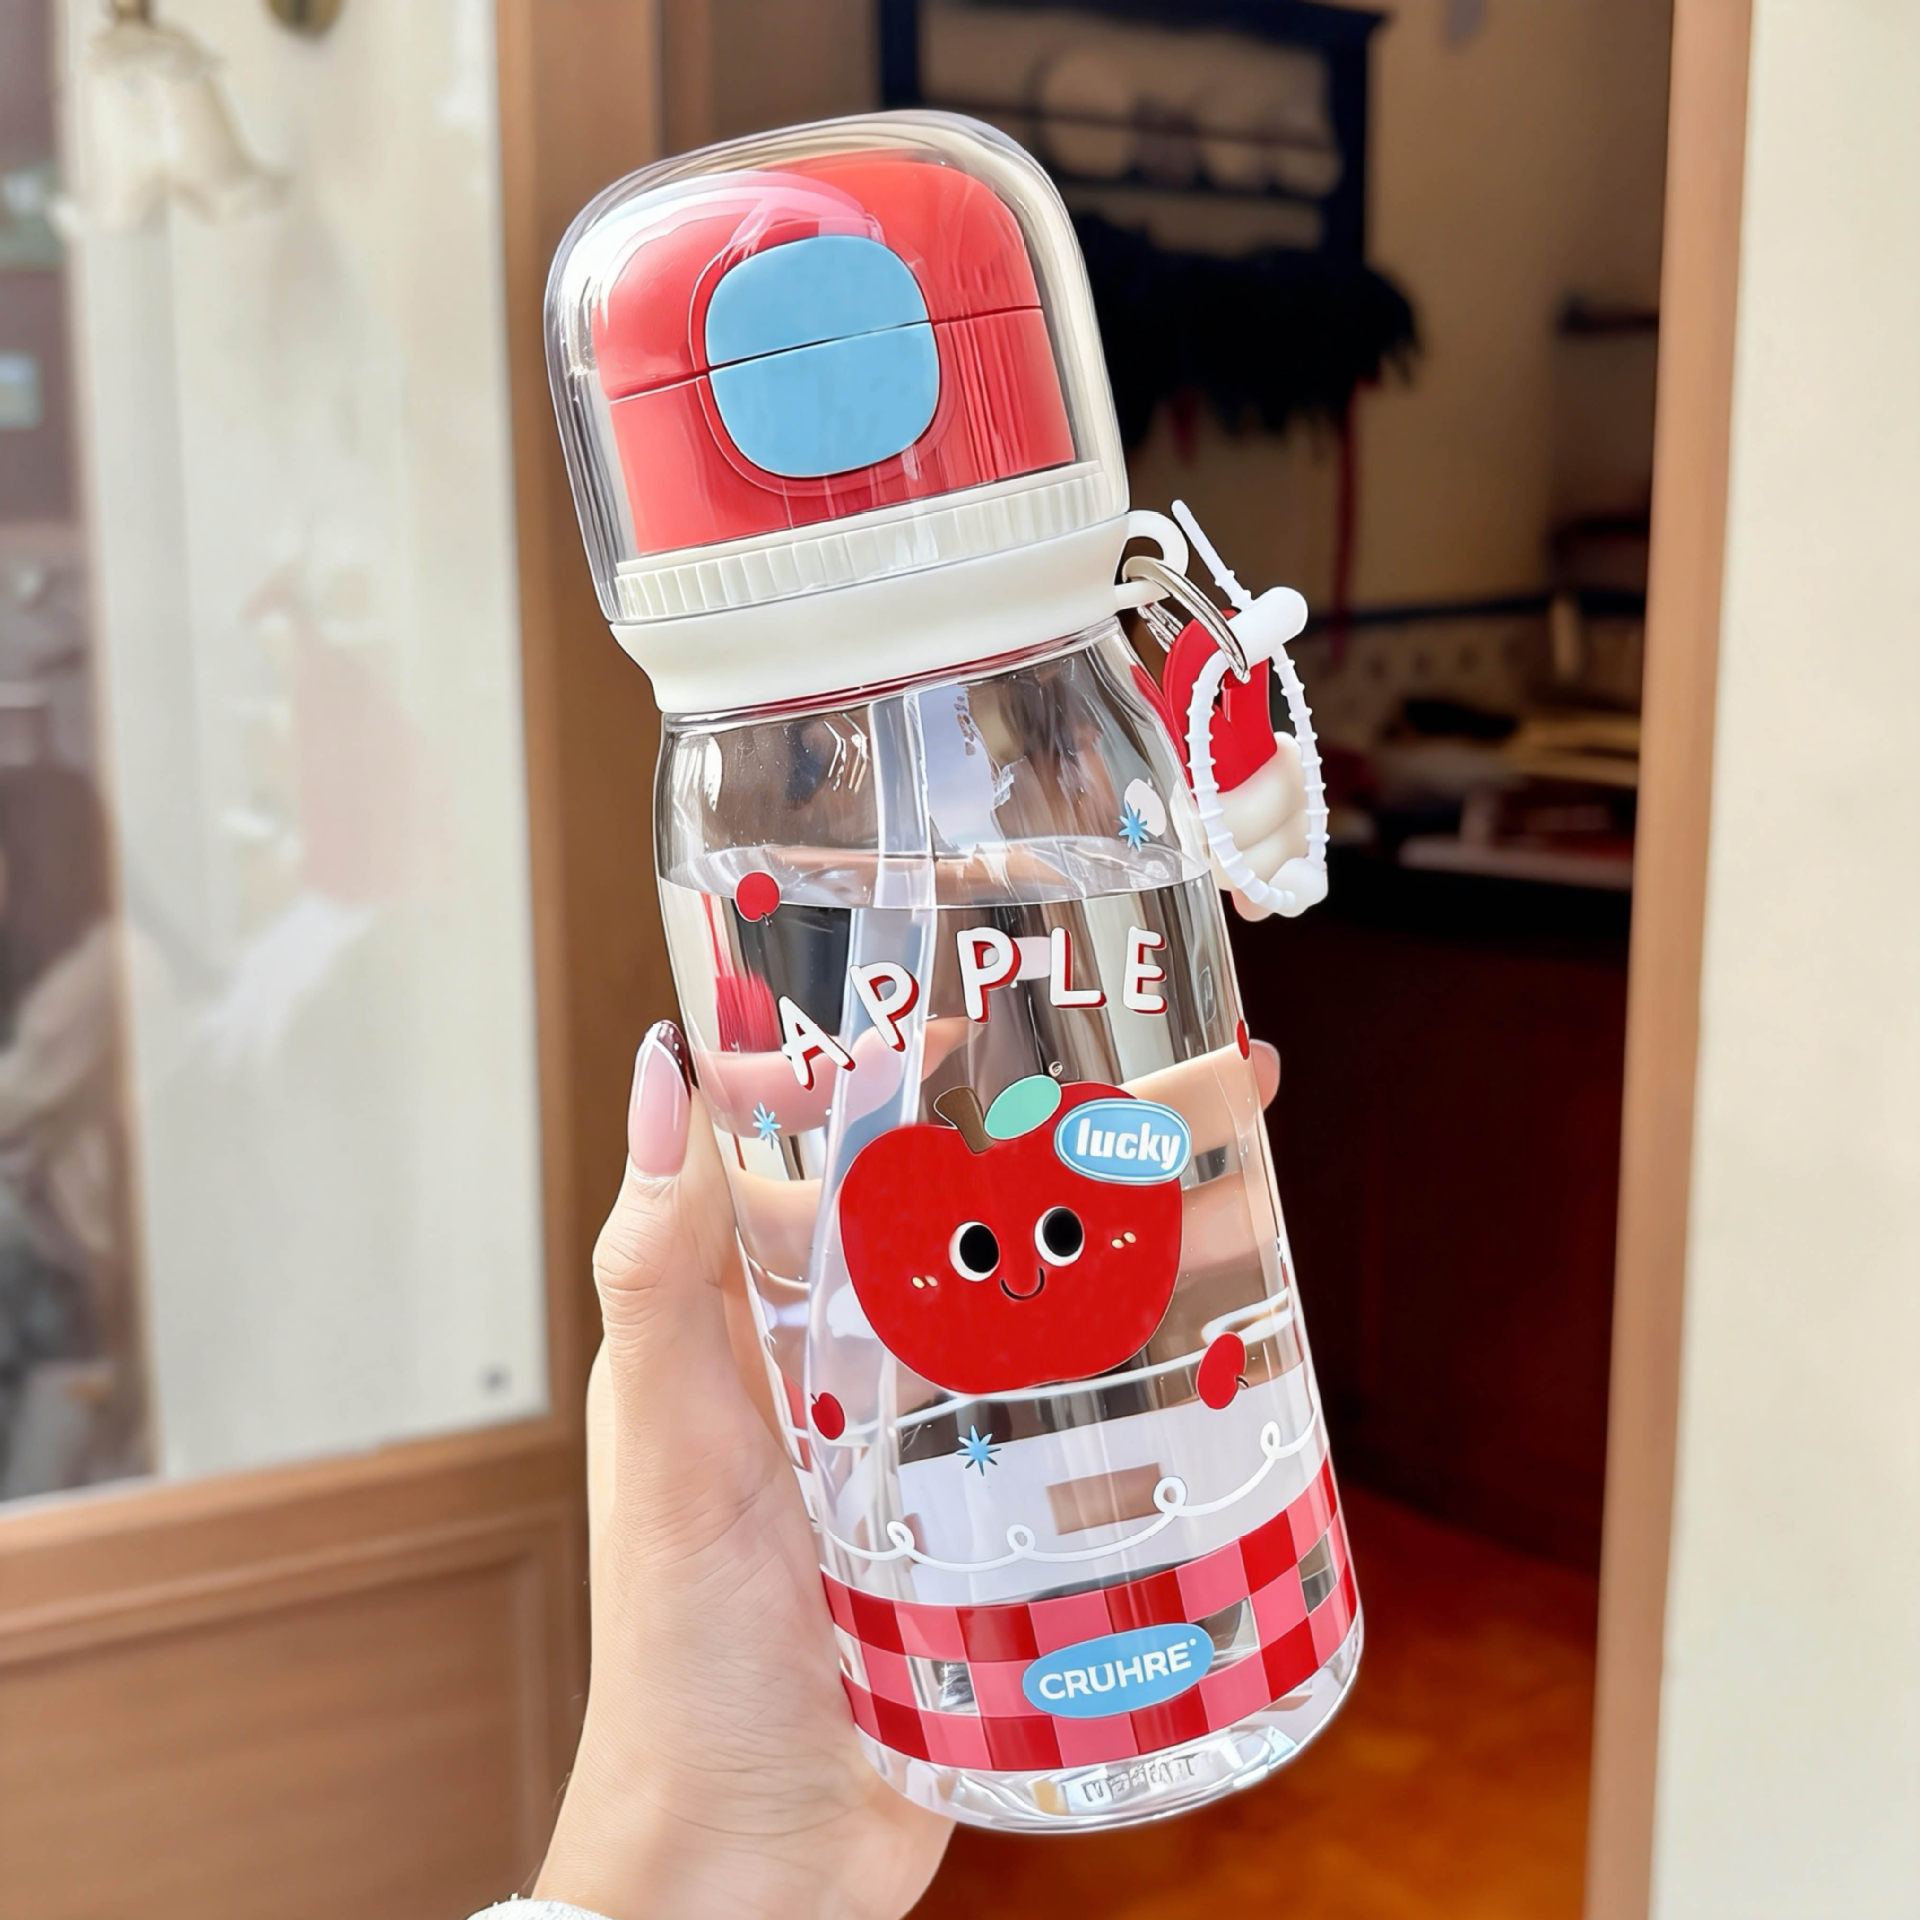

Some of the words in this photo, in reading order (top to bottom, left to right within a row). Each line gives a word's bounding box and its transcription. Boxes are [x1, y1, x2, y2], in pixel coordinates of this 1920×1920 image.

[777, 925, 1169, 1091] APPLE
[1076, 1117, 1181, 1171] lucky
[1038, 1640, 1194, 1700] CRUHRE
